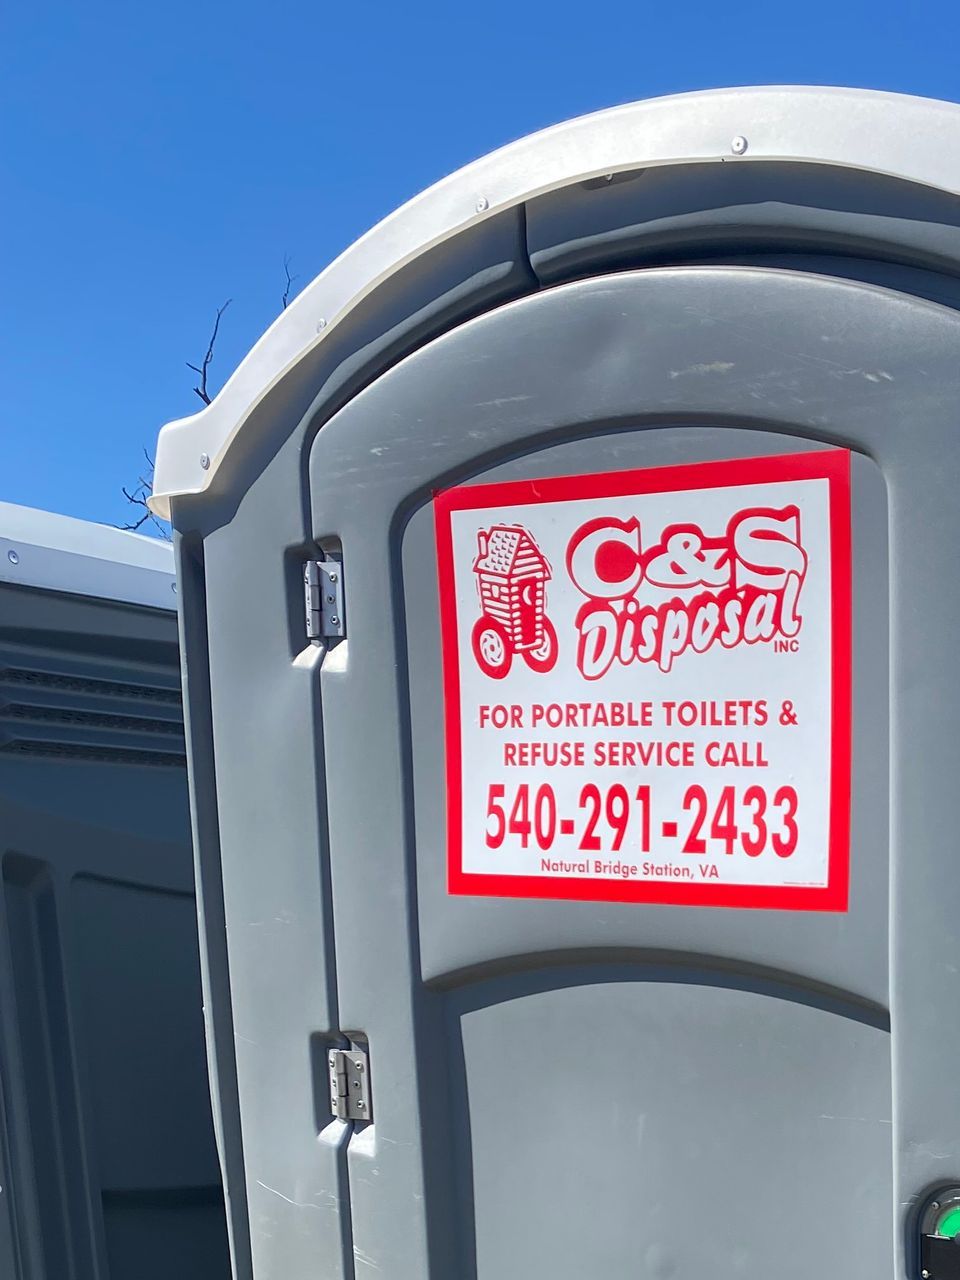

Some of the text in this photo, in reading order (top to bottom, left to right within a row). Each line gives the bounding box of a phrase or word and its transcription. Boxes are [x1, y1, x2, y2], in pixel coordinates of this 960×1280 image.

[566, 504, 808, 600] C&S
[575, 571, 803, 681] Disposal
[773, 639, 800, 653] INC
[479, 700, 799, 729] FOR PORTABLE TOILETS &
[504, 741, 768, 767] REFUSE SERVICE CALL
[485, 783, 799, 858] 540-291-2433
[541, 858, 719, 879] Natural Bridge Station, VA
